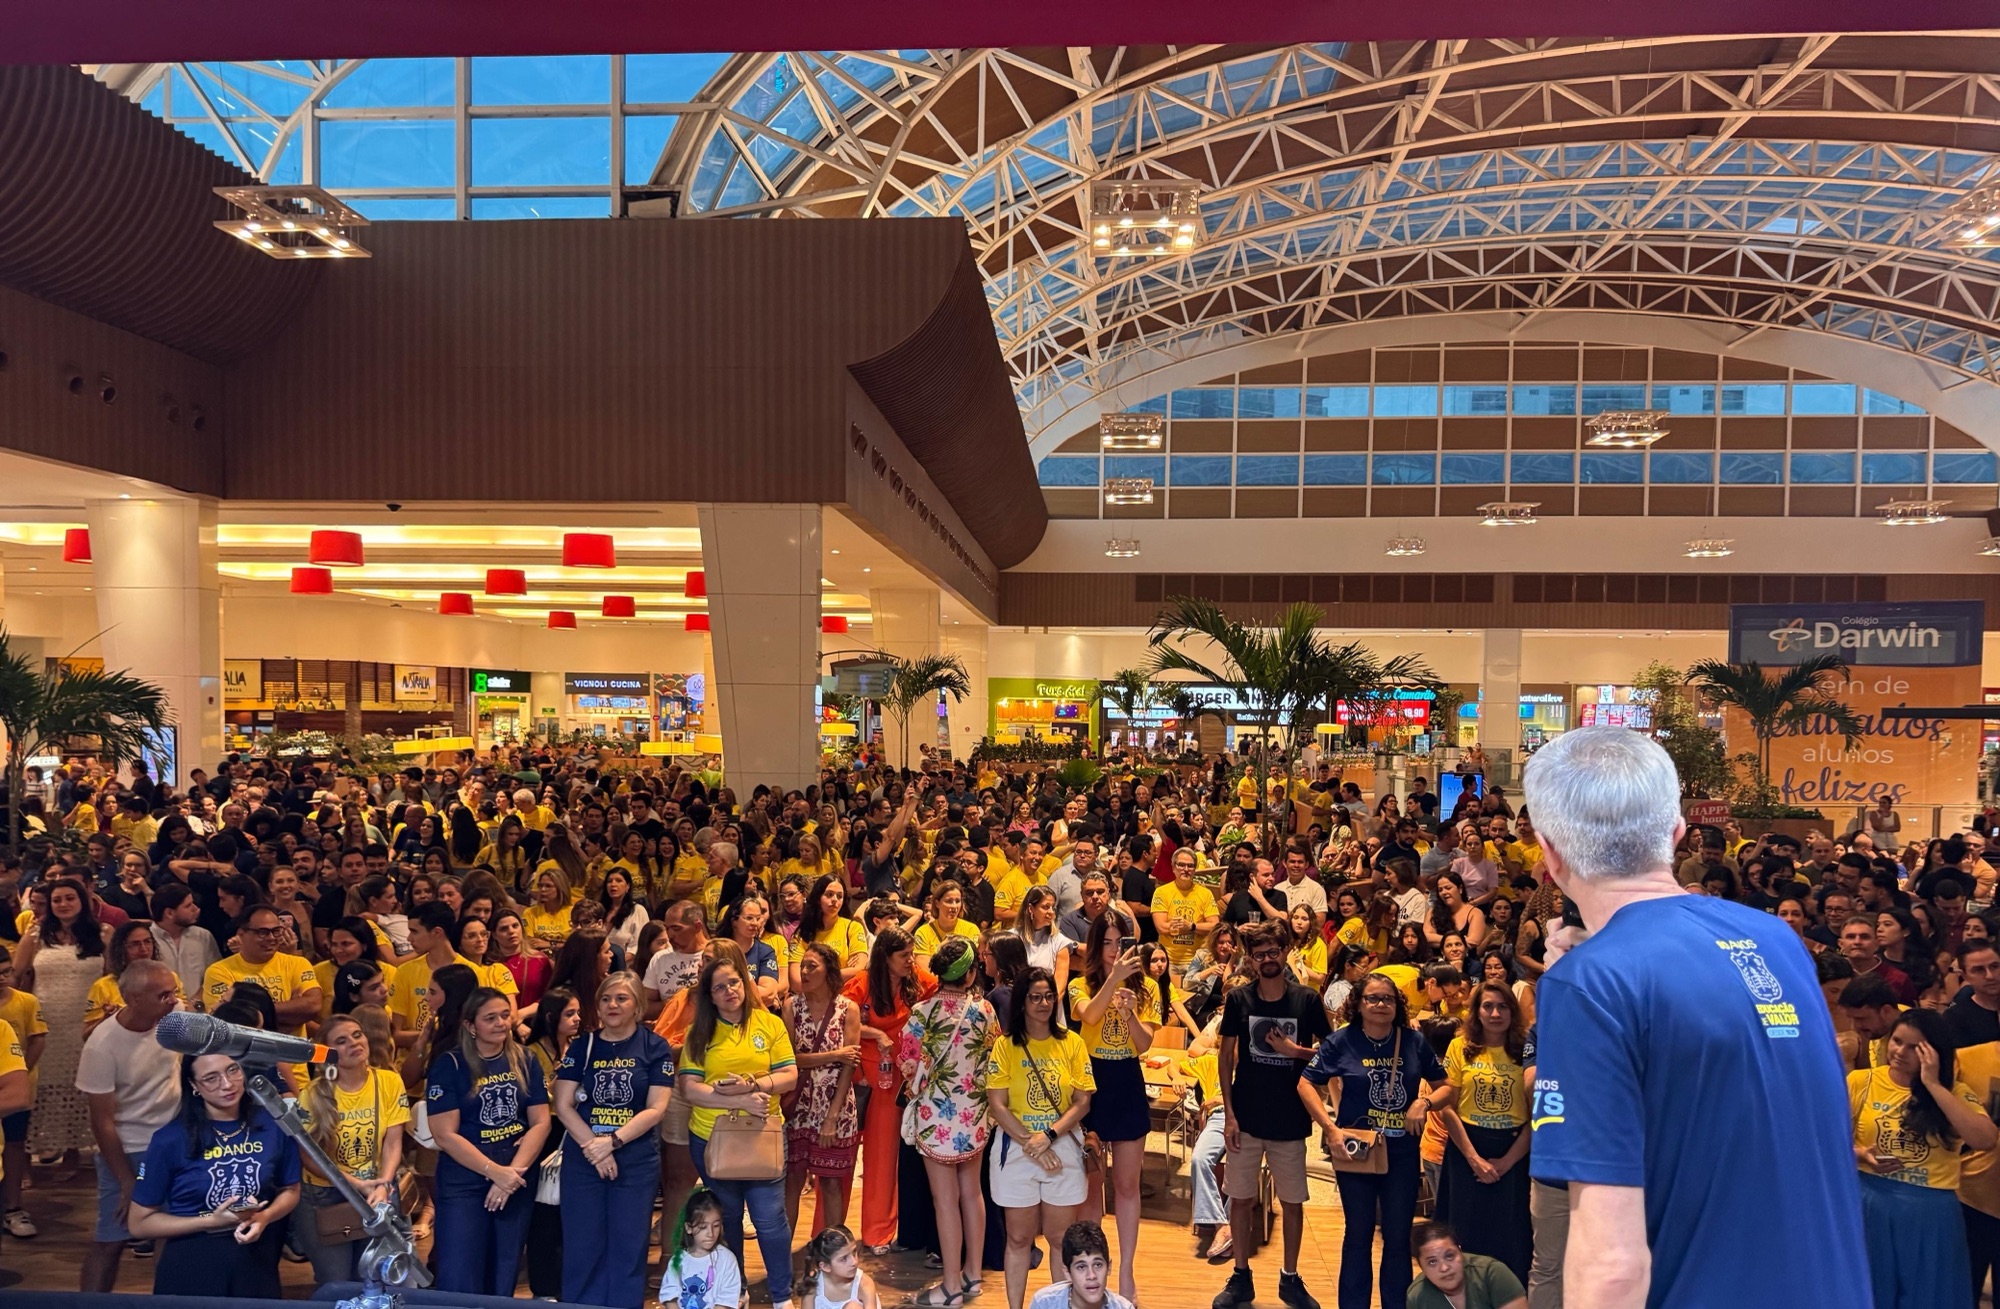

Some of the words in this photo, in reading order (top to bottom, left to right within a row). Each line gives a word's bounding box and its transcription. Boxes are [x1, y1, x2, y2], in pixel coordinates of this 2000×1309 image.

[1842, 616, 1878, 626] Colégio
[1814, 621, 1939, 648] Darwin
[574, 680, 608, 688] VIGNOLI
[1874, 675, 1909, 694] de
[1393, 687, 1436, 700] Camarão
[1781, 766, 1911, 805] felizes
[1690, 805, 1730, 816] HAPPY
[1701, 816, 1729, 824] hour
[1766, 1013, 1799, 1025] VALOR
[594, 1060, 607, 1069] 90
[1251, 1055, 1295, 1066] Technics
[1362, 1058, 1376, 1067] 90
[1484, 1062, 1515, 1072] ANOS
[488, 1071, 517, 1084] ANOS
[592, 1107, 634, 1118] EDUCAÇÃO
[1872, 1102, 1890, 1113] 90
[481, 1123, 523, 1138] EDUCAÇÃO
[223, 1141, 264, 1157] ANOS
